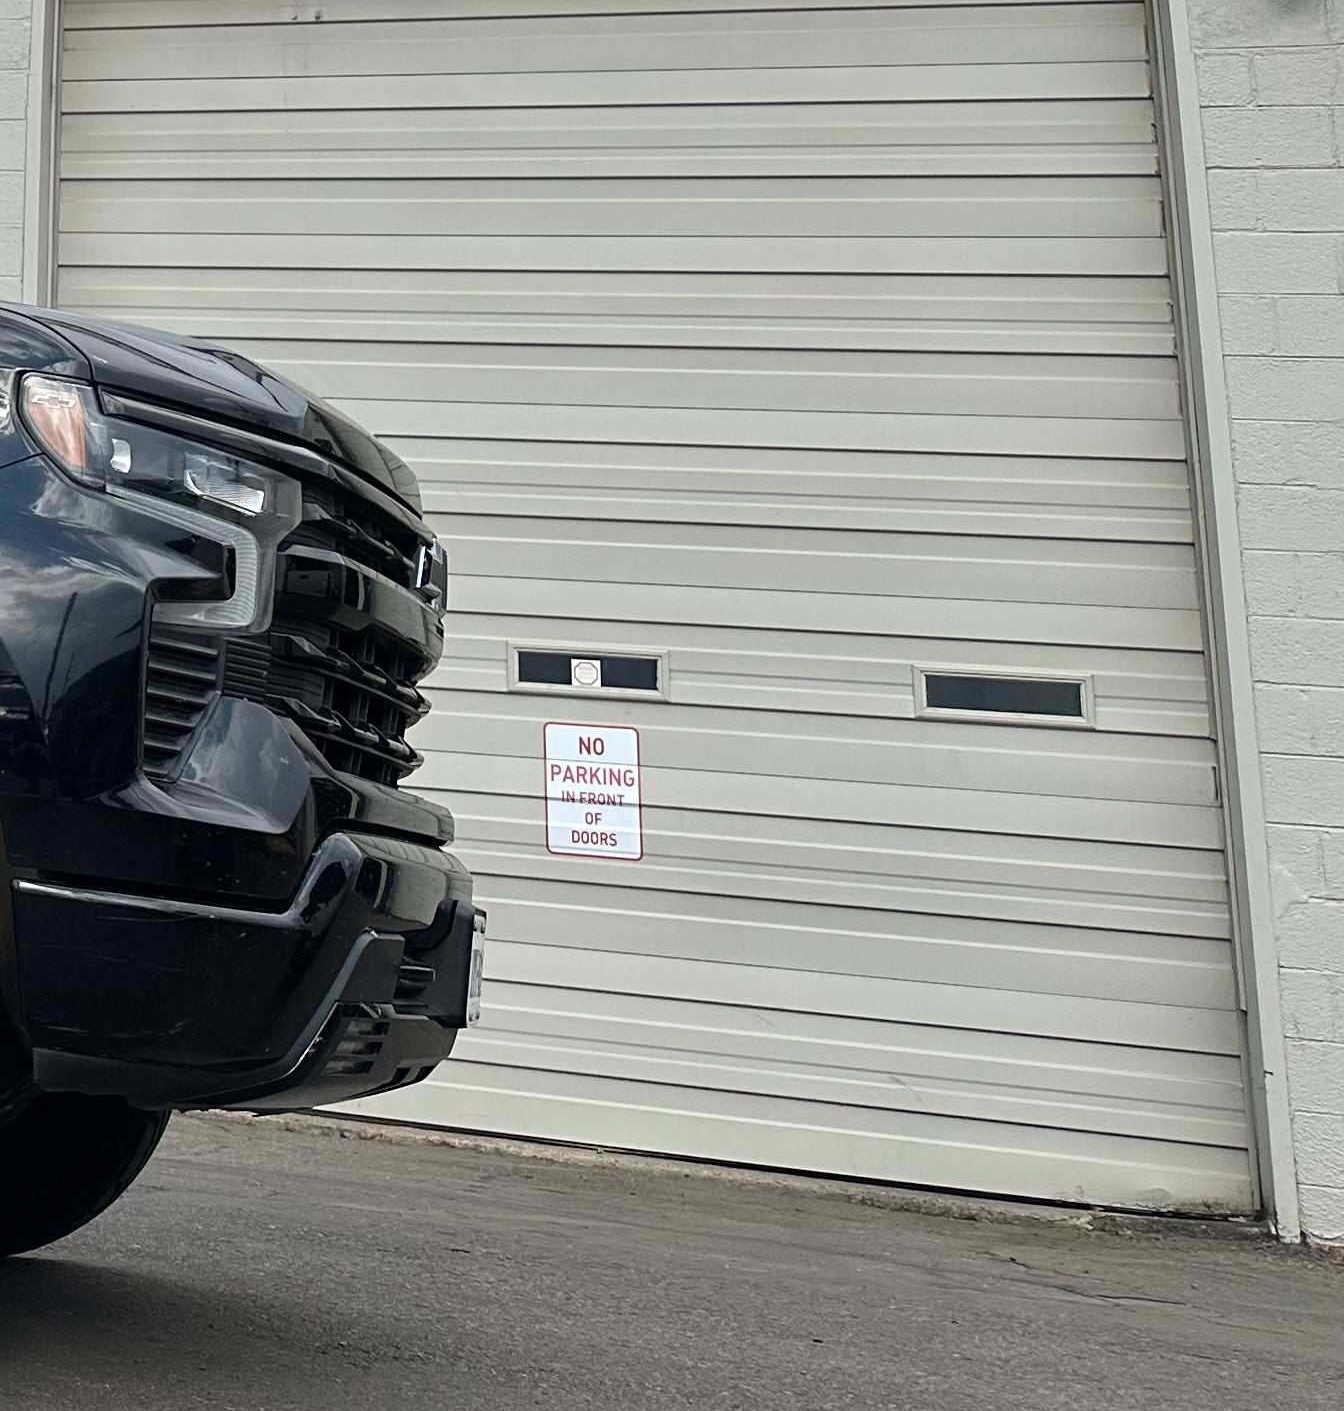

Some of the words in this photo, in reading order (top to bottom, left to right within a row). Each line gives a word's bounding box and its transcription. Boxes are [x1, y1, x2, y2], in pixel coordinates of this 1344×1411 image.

[578, 736, 605, 756] NO
[550, 763, 635, 787] PARKING
[562, 790, 576, 803] IN
[579, 791, 625, 807] FRONT
[585, 812, 602, 825] OF
[572, 830, 618, 847] DOORS
